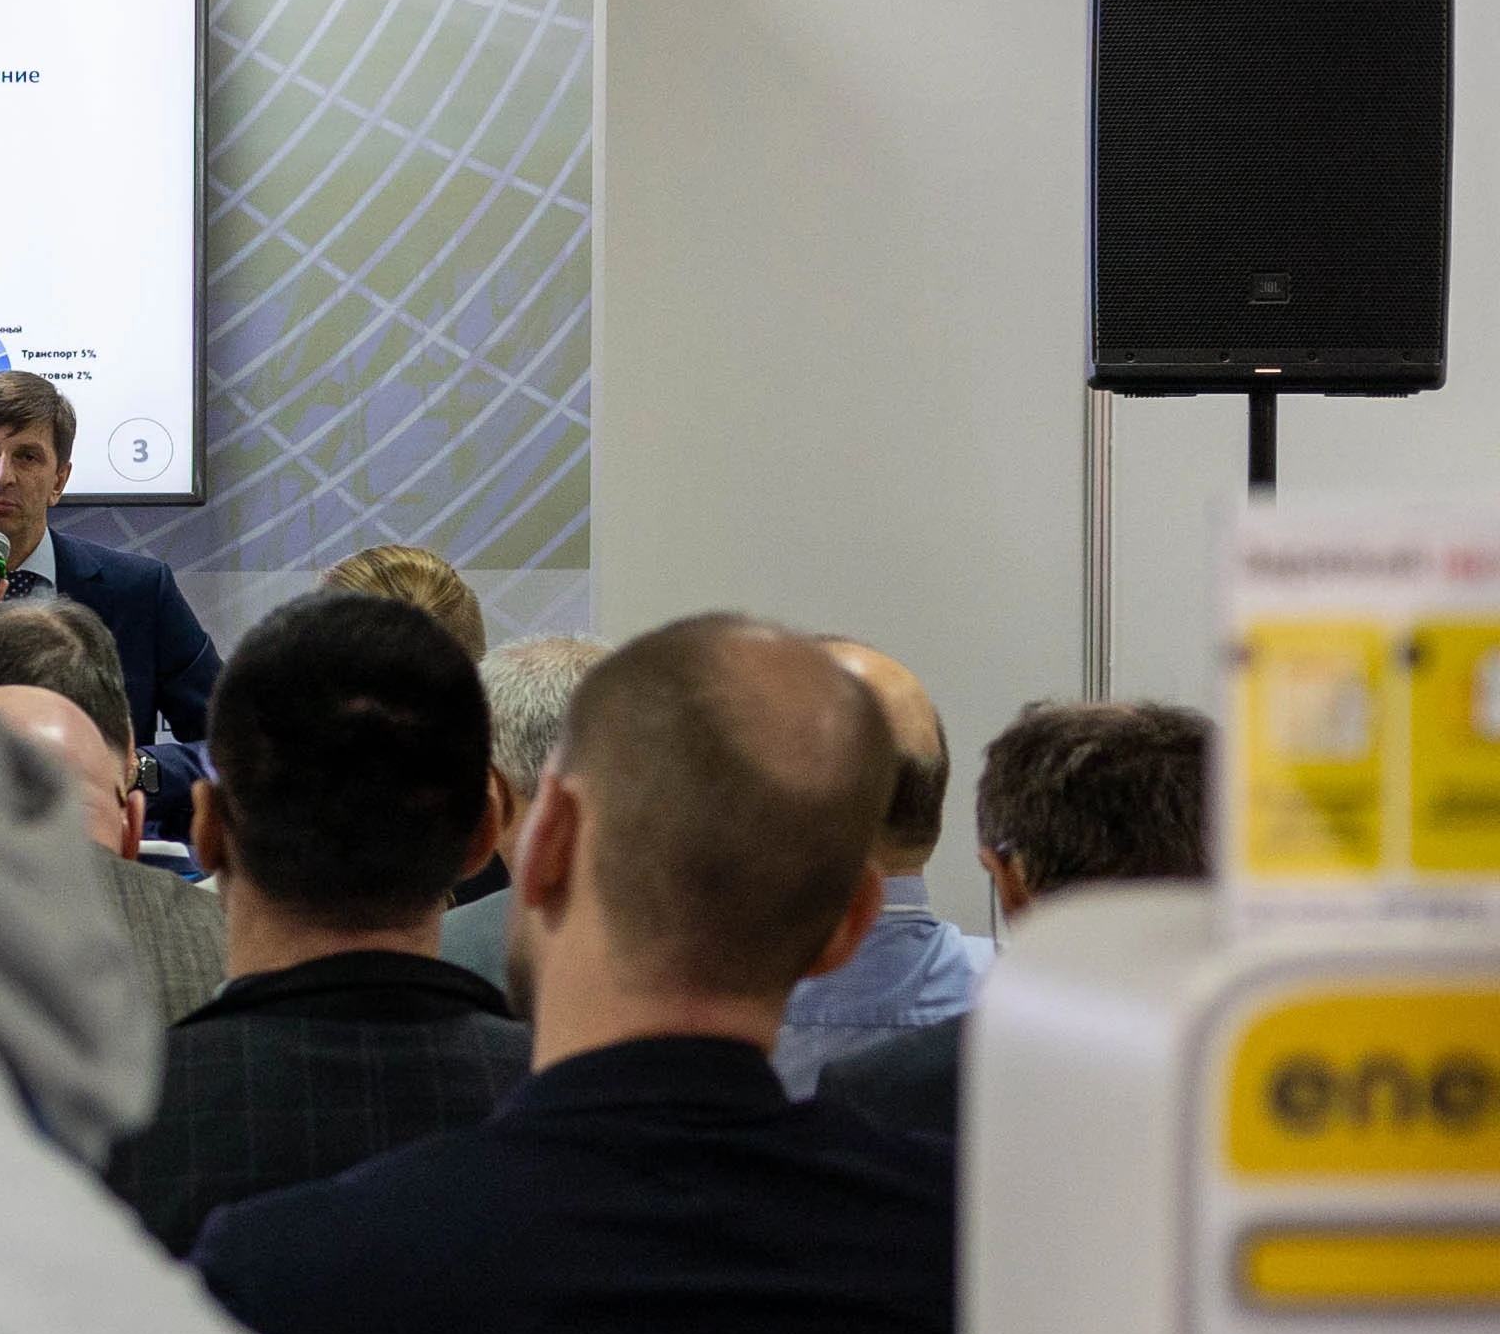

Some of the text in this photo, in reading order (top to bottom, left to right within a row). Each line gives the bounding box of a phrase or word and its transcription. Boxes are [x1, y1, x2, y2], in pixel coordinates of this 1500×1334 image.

[21, 348, 97, 360] Транспорт 5%
[76, 371, 93, 381] 2%
[131, 439, 149, 463] 3
